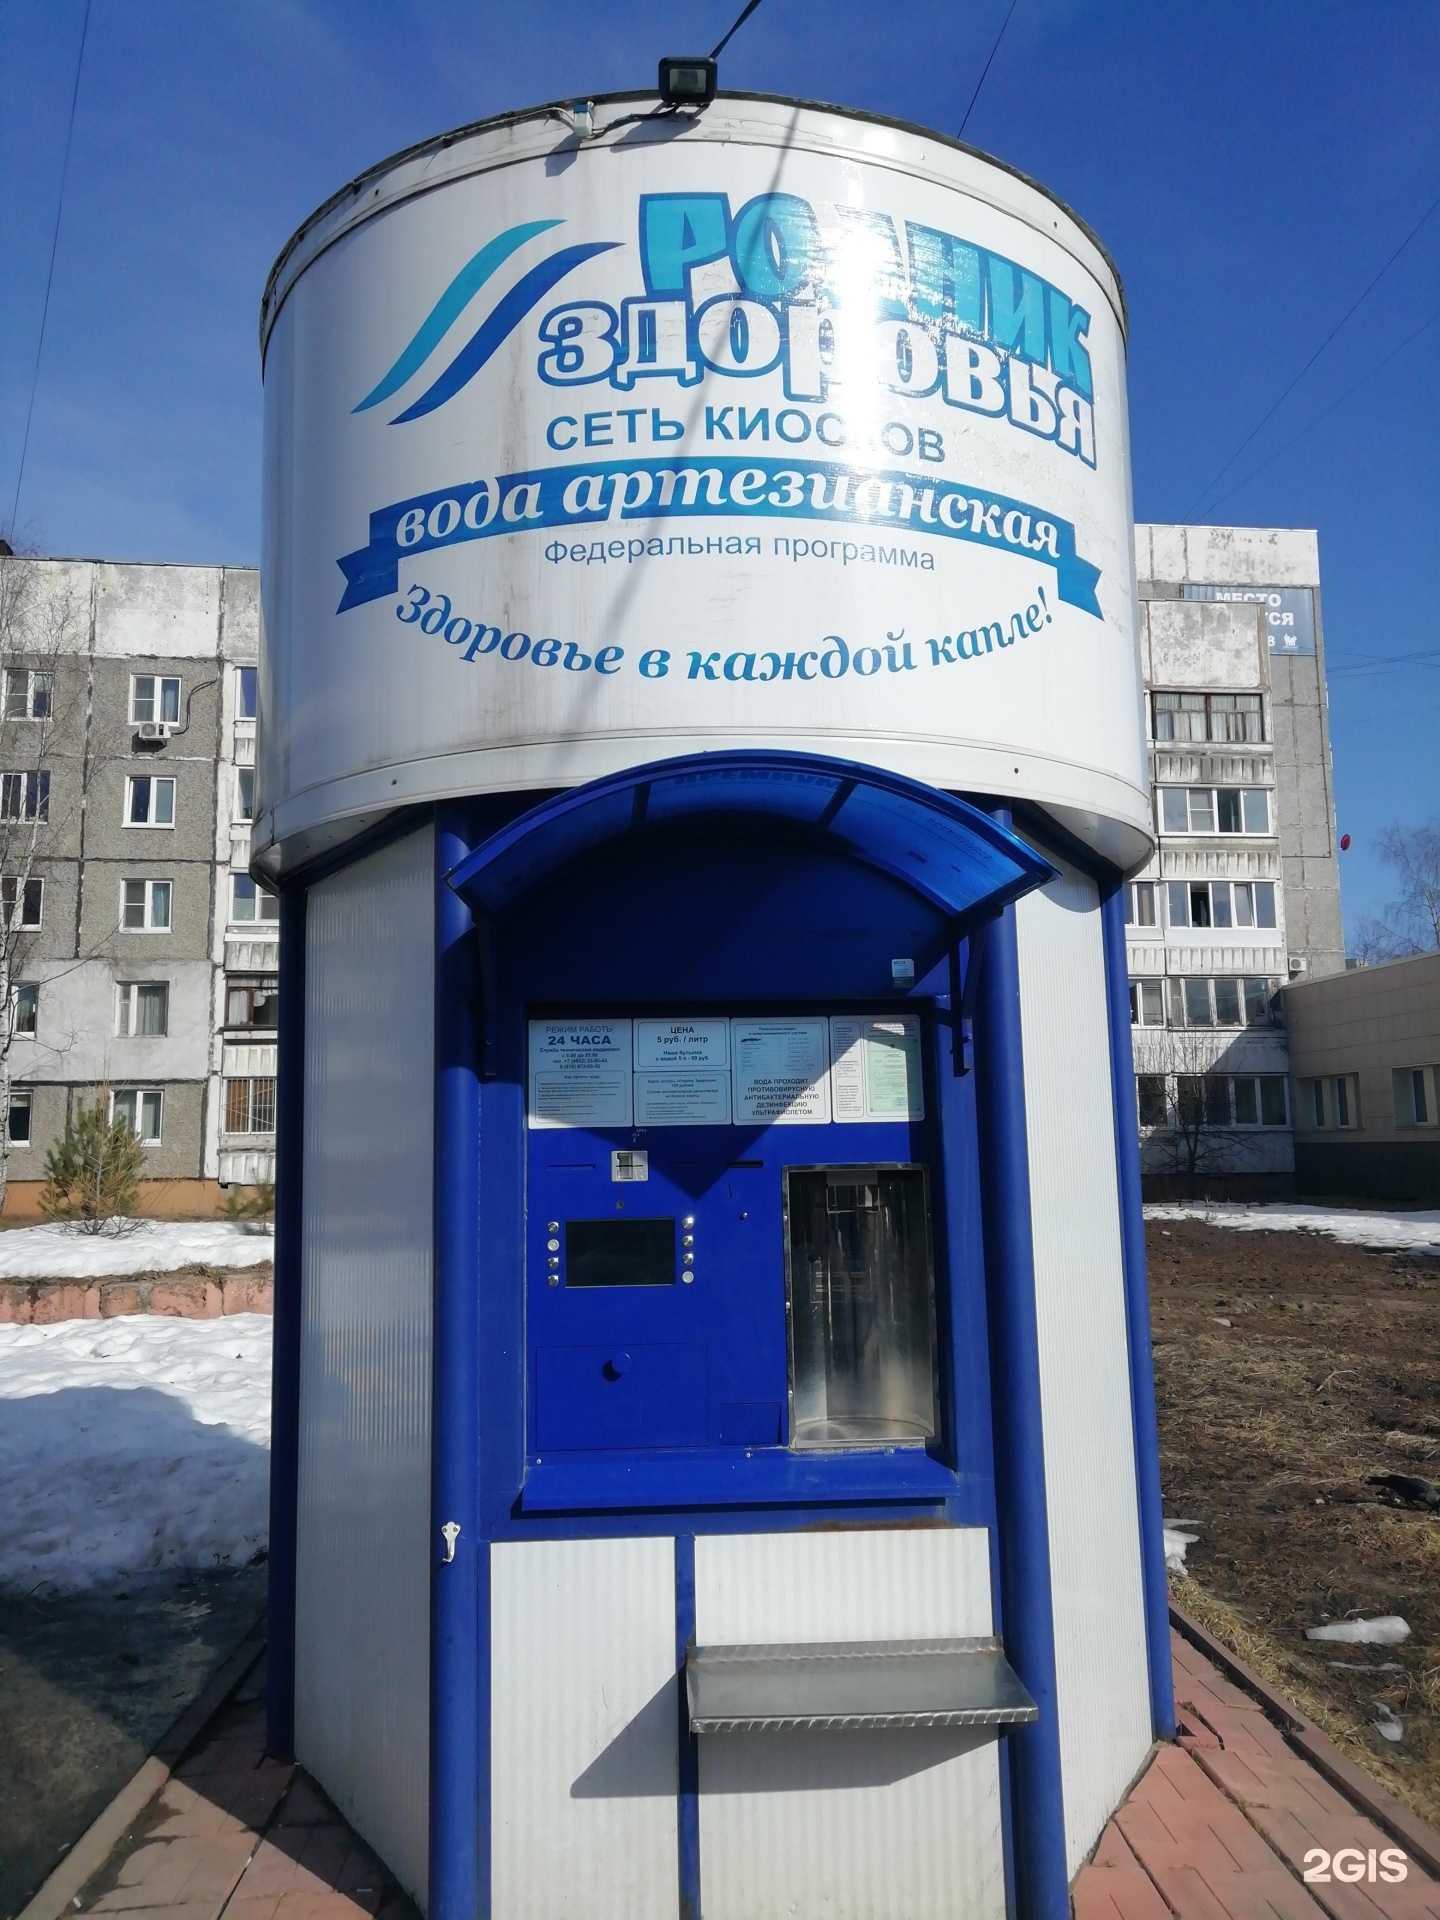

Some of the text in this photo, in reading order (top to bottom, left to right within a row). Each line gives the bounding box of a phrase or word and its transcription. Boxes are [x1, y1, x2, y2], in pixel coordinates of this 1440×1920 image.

[546, 405, 945, 463] СЕТЬ КИОСОВ
[396, 467, 1061, 558] вода артезианская
[544, 535, 935, 571] Федеральная программа
[396, 583, 1053, 682] Здоровье в каждой капле!
[548, 1035, 611, 1046] 24 ЧАСА
[670, 1026, 694, 1034] ЦЕНА
